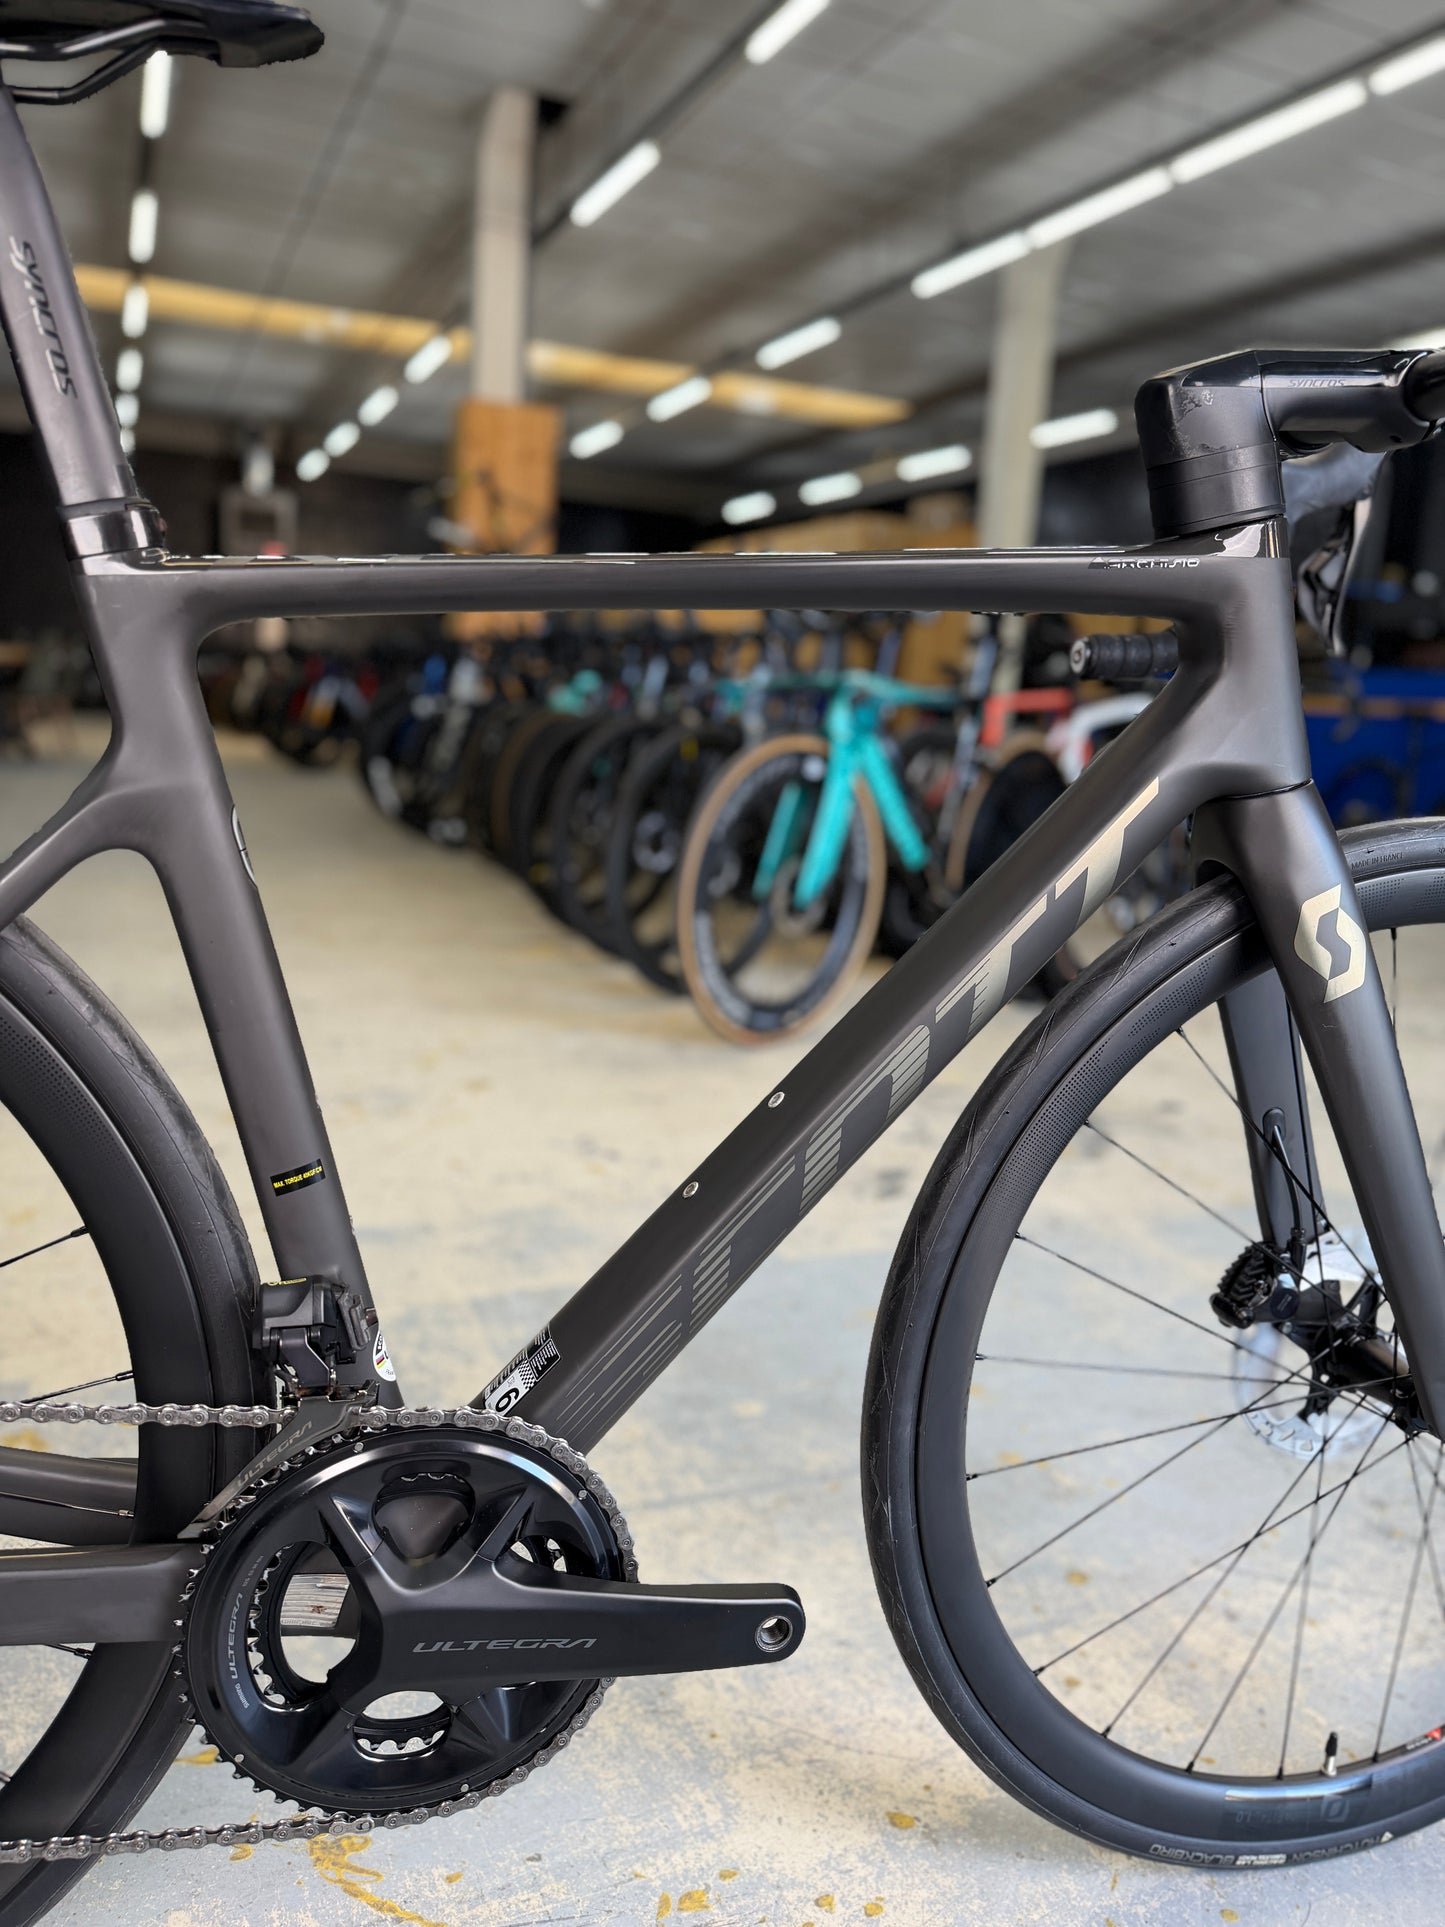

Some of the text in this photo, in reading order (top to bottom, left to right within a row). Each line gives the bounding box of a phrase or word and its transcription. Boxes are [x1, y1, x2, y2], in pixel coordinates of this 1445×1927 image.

[1288, 378, 1346, 388] SYNCROS
[238, 1420, 312, 1487] ULTEGRA
[229, 1592, 243, 1680] ULTEGRA
[411, 1636, 598, 1653] ULTEGRA
[234, 1682, 250, 1709] SHIMANO
[1150, 1844, 1234, 1865] BLACKBIRD
